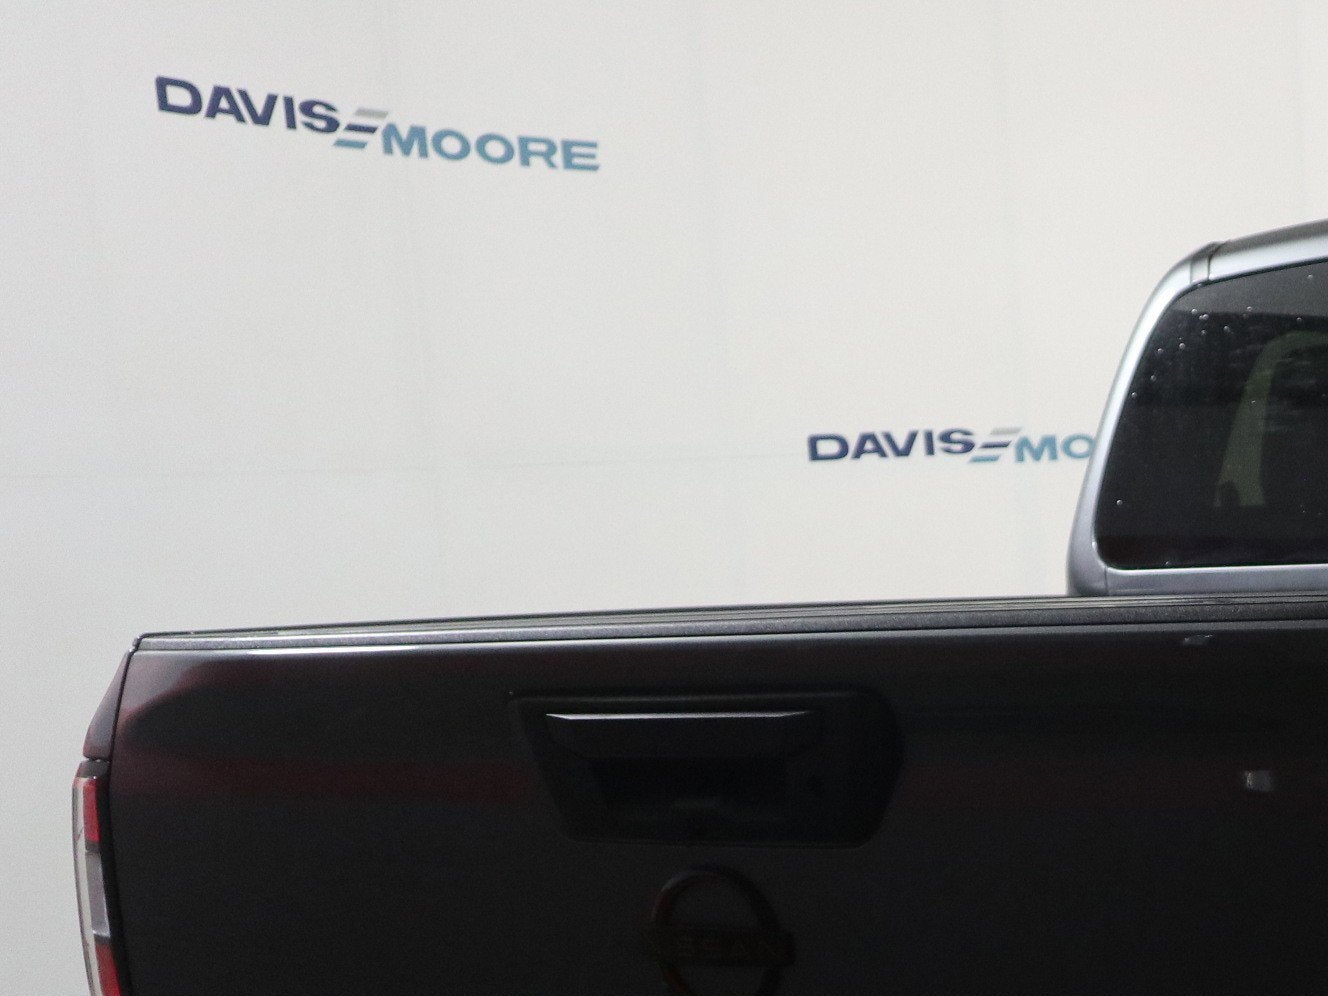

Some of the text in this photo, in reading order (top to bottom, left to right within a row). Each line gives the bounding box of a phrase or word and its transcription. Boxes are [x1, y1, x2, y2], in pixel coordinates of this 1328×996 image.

[155, 75, 601, 172] DAVIS MOORE
[808, 429, 975, 461] DAVIS
